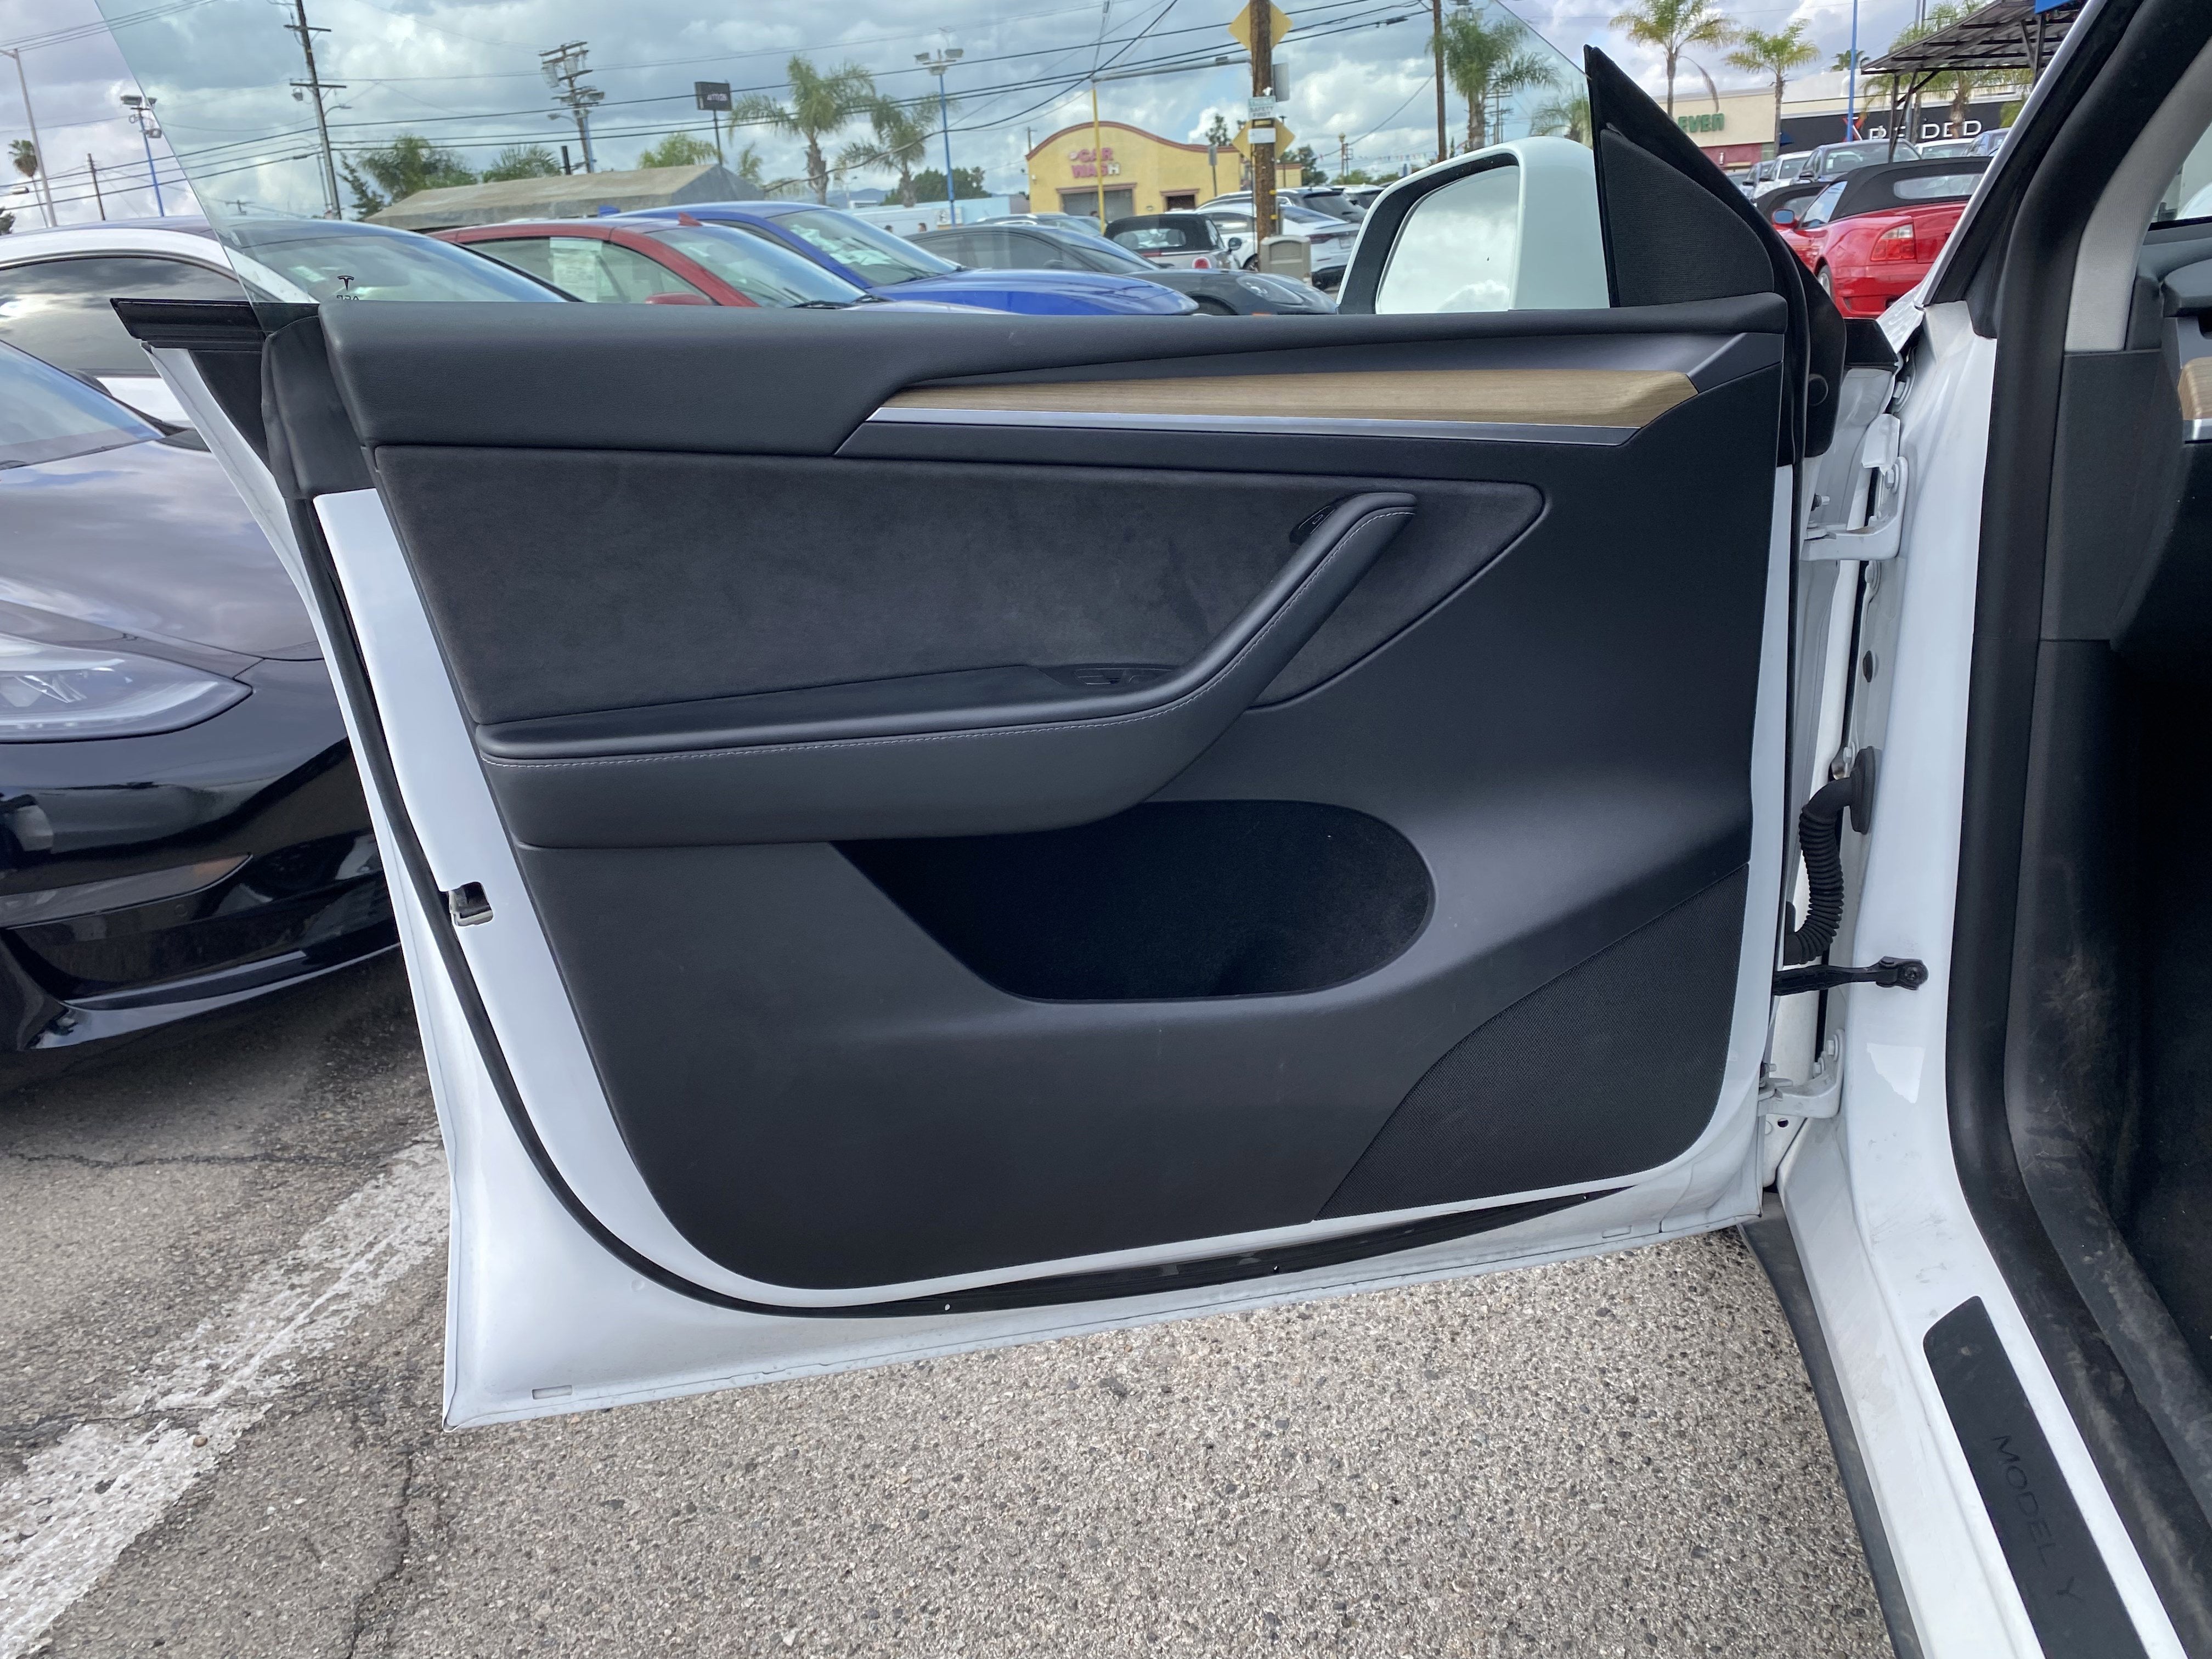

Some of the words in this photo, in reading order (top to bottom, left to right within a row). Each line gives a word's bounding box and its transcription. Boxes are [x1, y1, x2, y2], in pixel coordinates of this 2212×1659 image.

[1079, 147, 1114, 162] CAR
[1071, 162, 1120, 178] WASH
[1991, 1435, 2056, 1568] MODEL
[2056, 1576, 2084, 1603] Y
